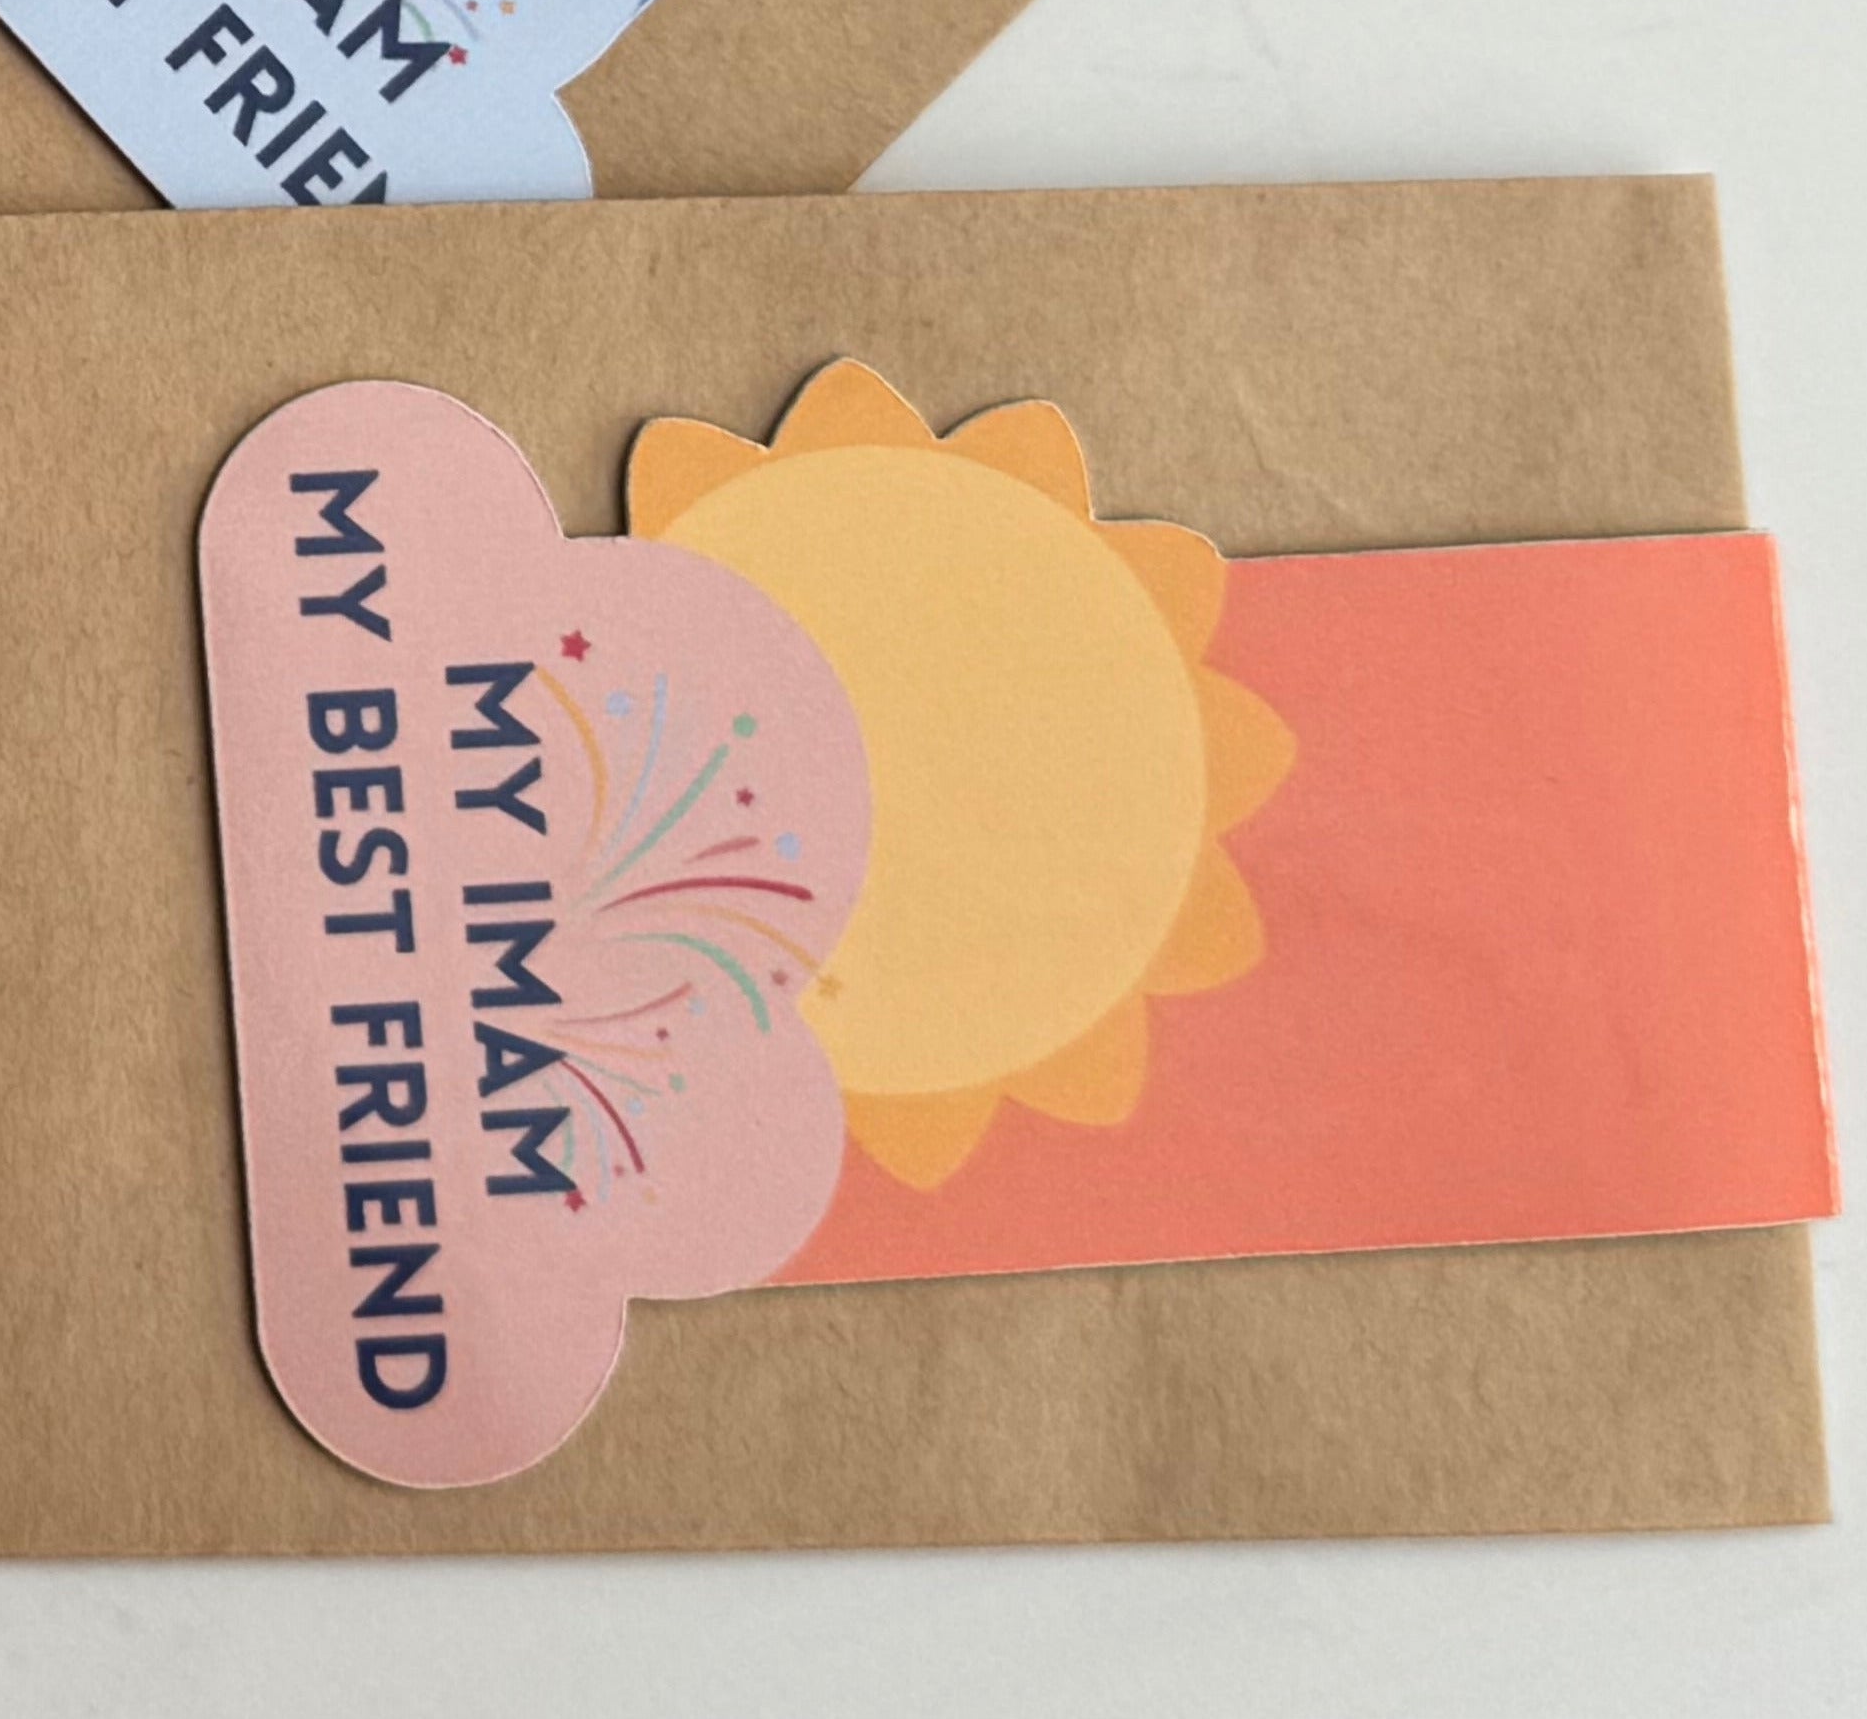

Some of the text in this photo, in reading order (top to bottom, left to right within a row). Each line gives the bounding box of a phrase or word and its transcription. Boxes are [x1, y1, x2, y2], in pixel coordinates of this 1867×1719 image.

[164, 3, 388, 206] FRIE
[289, 469, 448, 1411] MY BEST FRIEND
[445, 662, 578, 1197] MY IMAM
